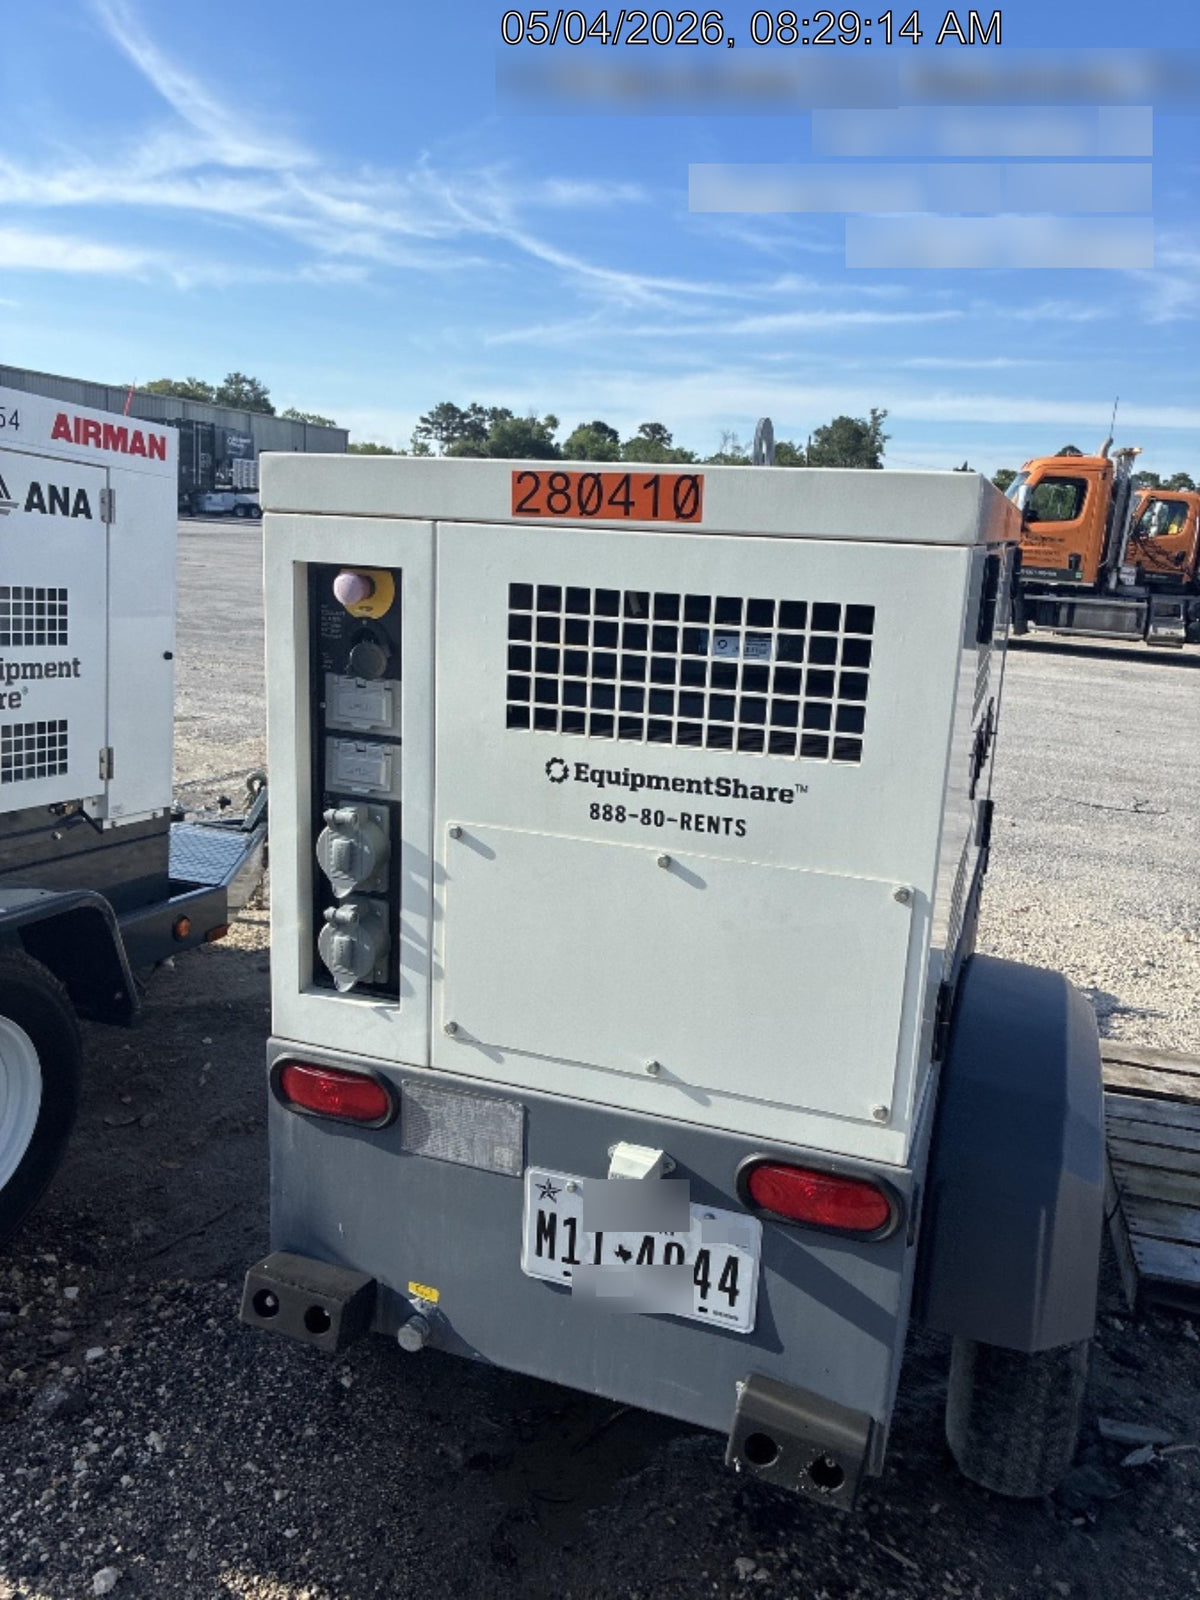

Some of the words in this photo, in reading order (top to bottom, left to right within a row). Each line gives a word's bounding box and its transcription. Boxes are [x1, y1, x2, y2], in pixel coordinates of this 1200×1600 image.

[51, 412, 166, 461] AIRMAN
[24, 481, 93, 520] ANA
[514, 470, 701, 520] 280410
[588, 802, 748, 838] 888-80-RENTS
